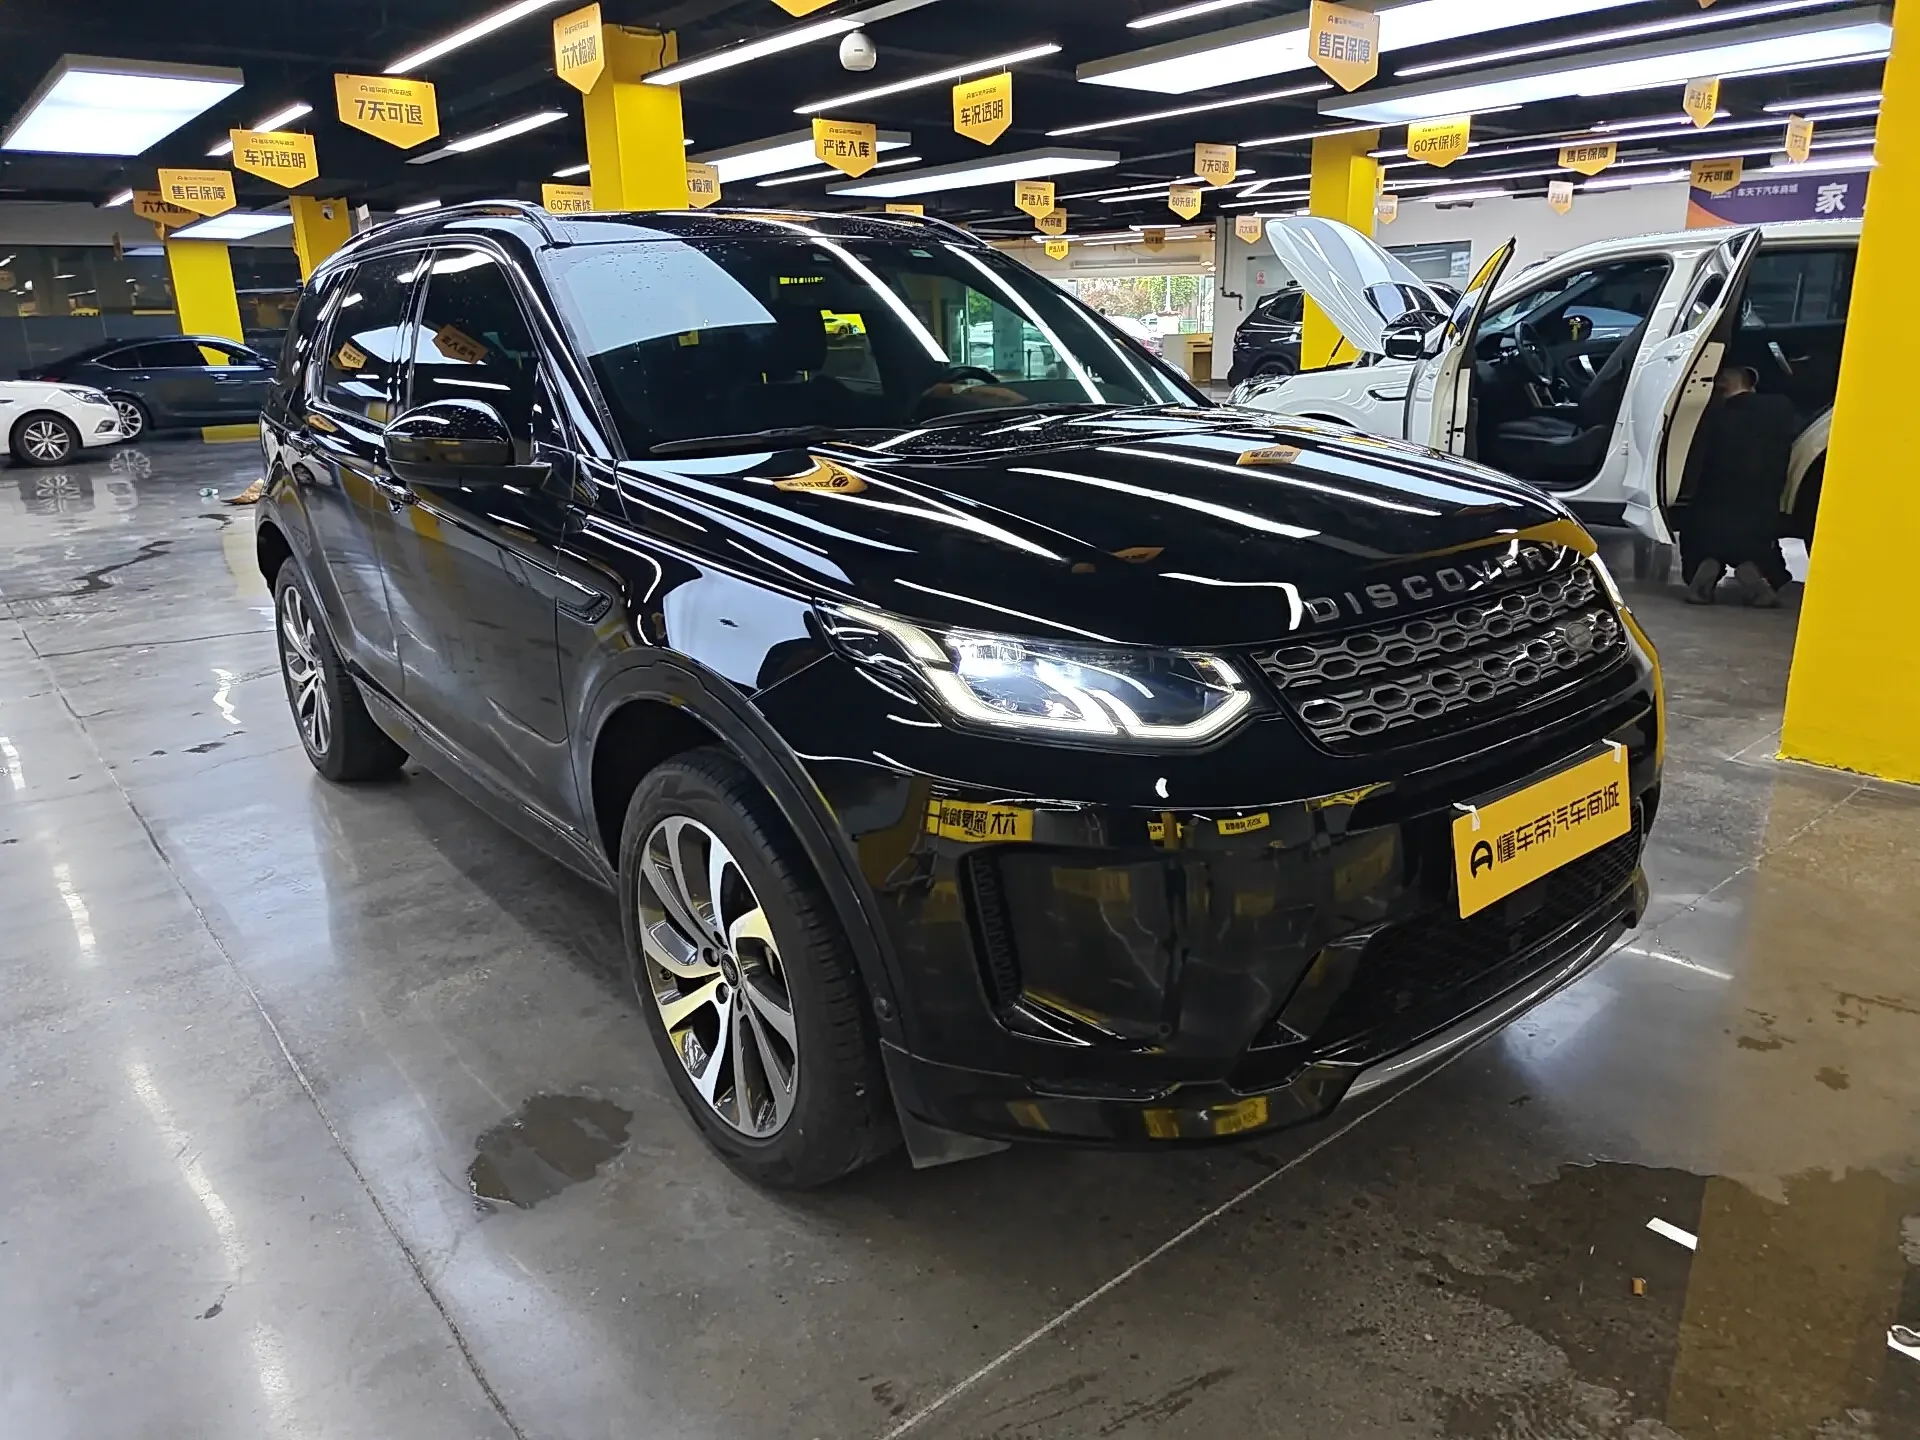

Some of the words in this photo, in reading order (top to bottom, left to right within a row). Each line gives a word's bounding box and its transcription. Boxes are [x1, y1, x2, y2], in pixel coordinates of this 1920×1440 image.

[562, 35, 597, 70] 六大检测
[1318, 31, 1370, 63] 售后保障
[354, 99, 423, 126] 7天可退
[960, 99, 1004, 127] 车况透明
[824, 139, 869, 157] 严选入库
[1413, 133, 1462, 153] 60天保修
[244, 149, 307, 169] 车况透明
[1202, 160, 1229, 173] 7天可退
[1697, 170, 1733, 184] 7天可退
[171, 185, 226, 200] 售后保障
[1021, 193, 1050, 206] 严选入库
[1815, 183, 1848, 214] 家
[551, 199, 592, 212] 60天保修
[1303, 540, 1561, 623] DISCOVERY
[1497, 780, 1620, 864] 懂车帝汽车商城
